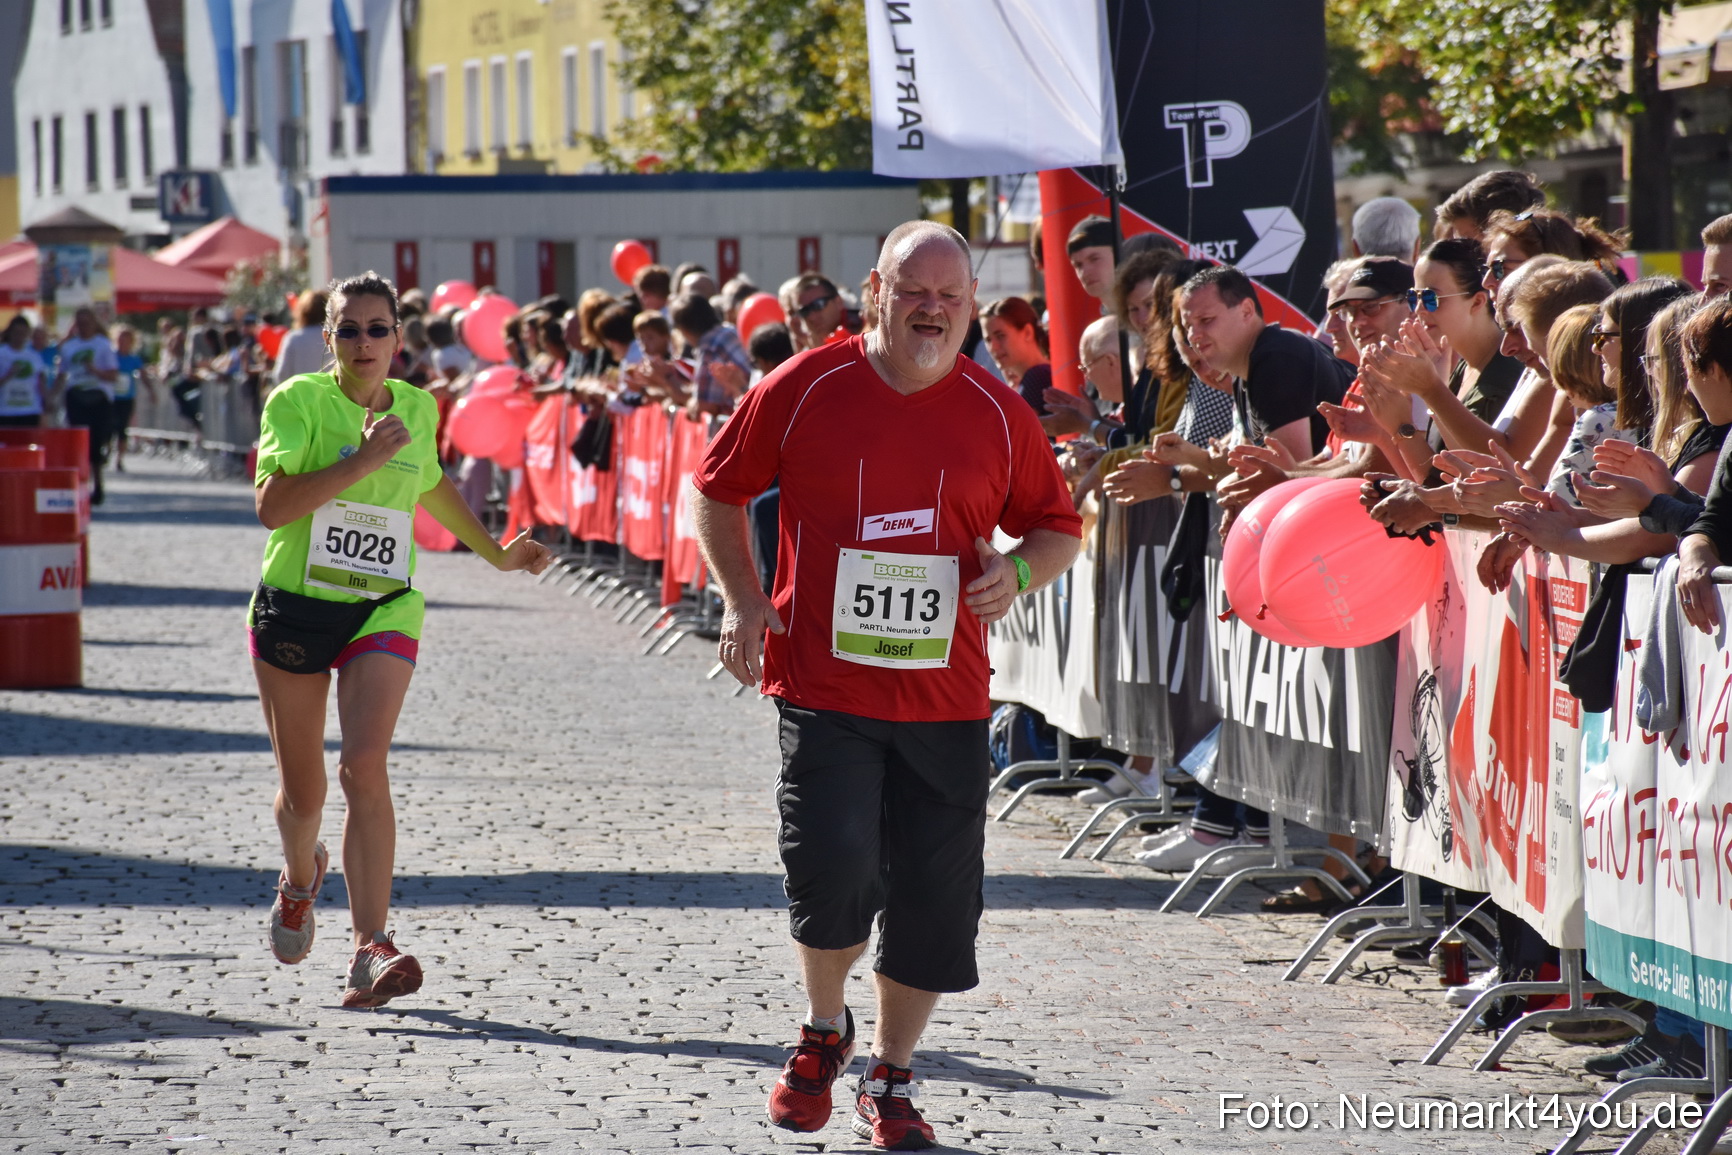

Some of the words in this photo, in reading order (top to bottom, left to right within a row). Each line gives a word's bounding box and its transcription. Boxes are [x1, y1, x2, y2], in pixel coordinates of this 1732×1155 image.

[1188, 240, 1238, 260] NEXT
[344, 510, 388, 528] BOCK
[882, 518, 915, 531] DEHN
[325, 525, 397, 566] 5028
[330, 558, 351, 568] PARTL
[351, 563, 380, 573] Neumarkt
[874, 563, 927, 578] BOCK
[348, 574, 368, 588] Ina
[853, 584, 941, 622] 5113
[859, 623, 885, 632] PARTL
[886, 626, 921, 635] Neumarkt
[874, 640, 914, 656] Josef
